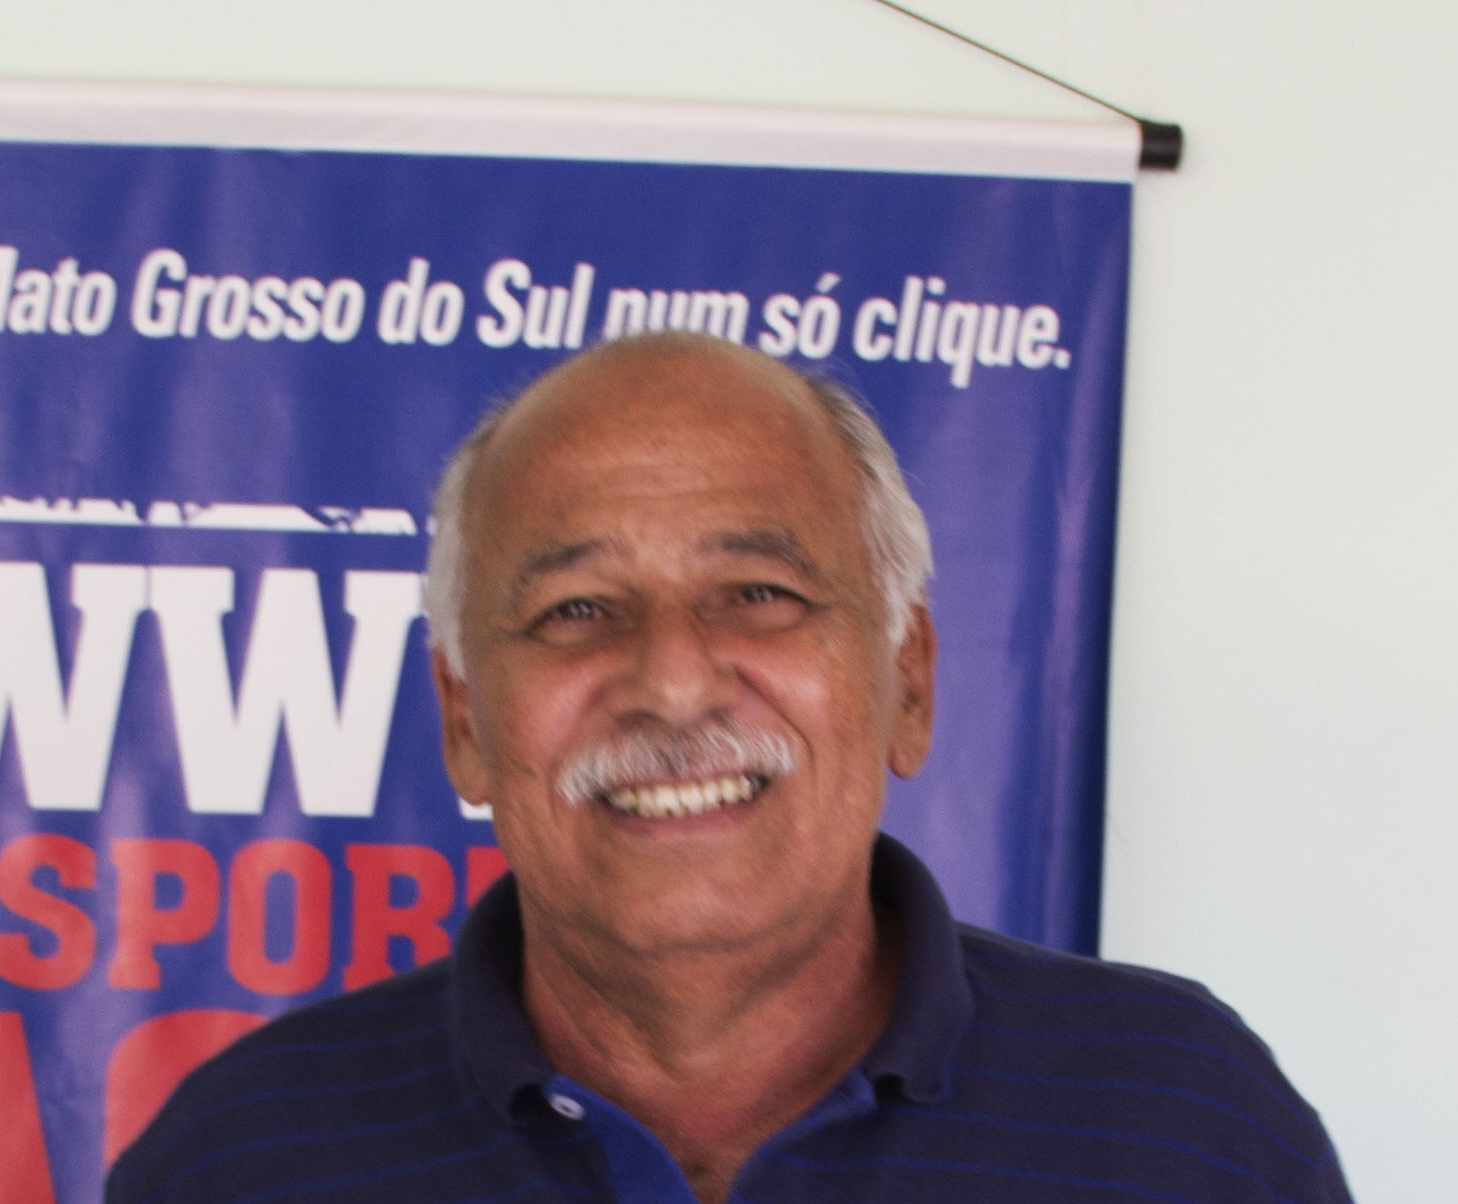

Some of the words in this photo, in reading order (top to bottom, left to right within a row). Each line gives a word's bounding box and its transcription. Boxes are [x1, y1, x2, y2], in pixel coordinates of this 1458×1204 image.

[131, 248, 365, 343] Grosso
[377, 258, 465, 346] do
[476, 259, 596, 350] Sul
[758, 272, 841, 359] só
[853, 276, 1071, 389] clique.
